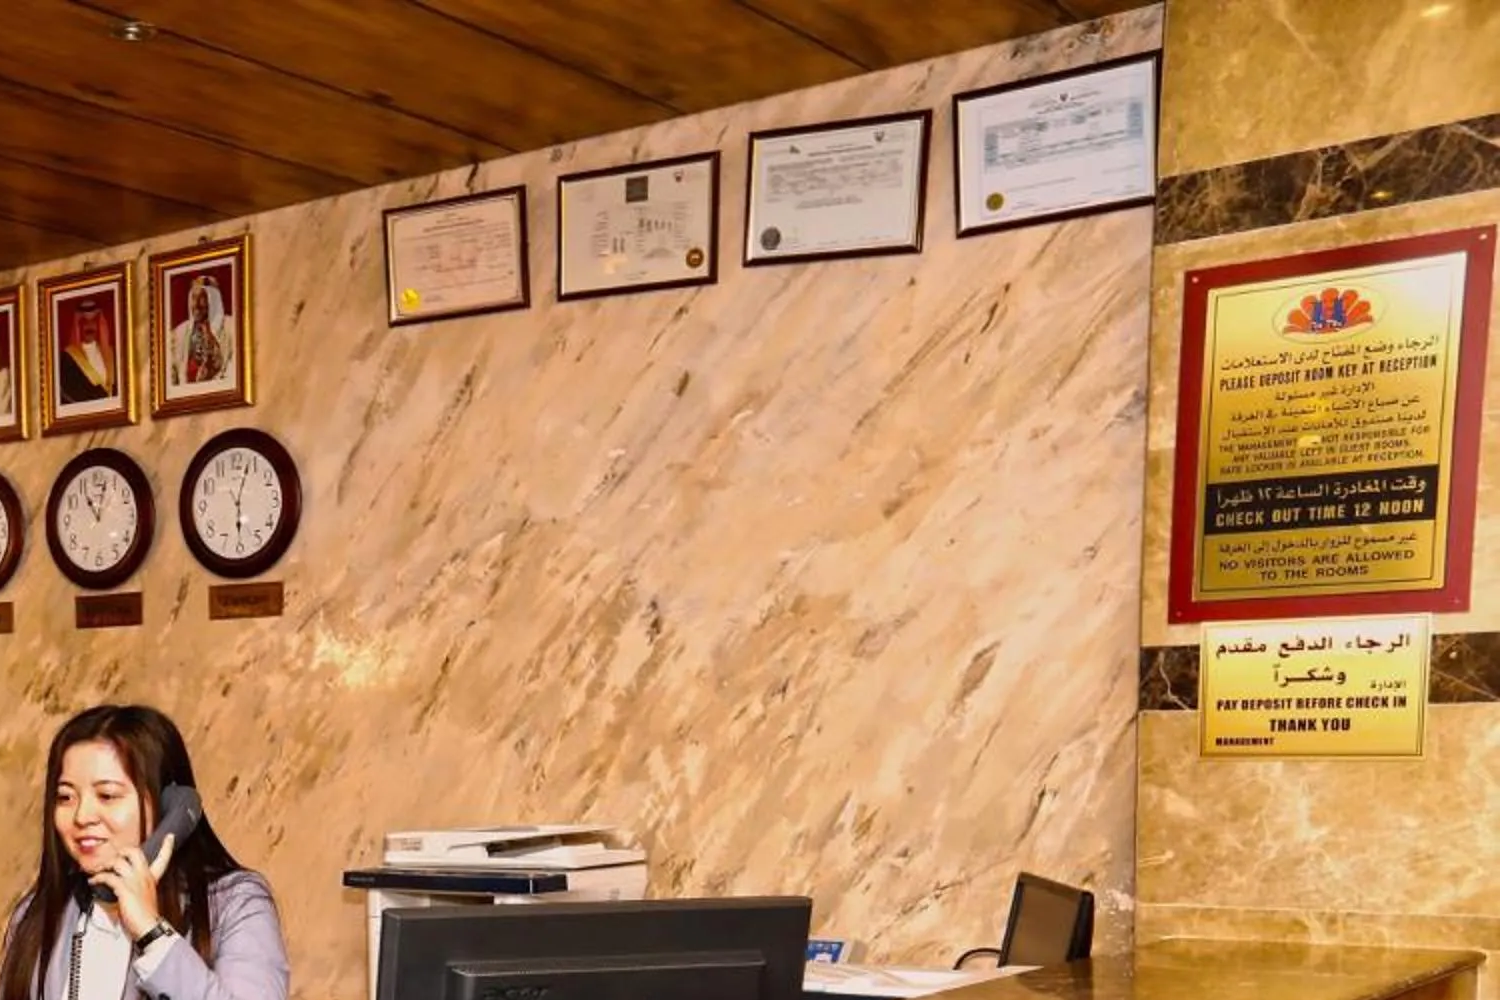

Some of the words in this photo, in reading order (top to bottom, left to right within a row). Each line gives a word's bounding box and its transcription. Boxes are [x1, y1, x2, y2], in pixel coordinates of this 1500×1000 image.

[1220, 375, 1256, 392] PLEASE
[1260, 369, 1301, 387] DEPOSIT
[1304, 366, 1334, 383] ROOM
[1338, 363, 1358, 378] KEY
[1361, 361, 1376, 375] AT
[1379, 354, 1438, 373] RECEPTION
[1219, 443, 1234, 453] THE
[1238, 438, 1298, 451] MANAGEMENT
[1321, 434, 1339, 444] NOT
[1411, 424, 1431, 435] FOR
[1300, 446, 1323, 457] LEFT
[1276, 482, 1330, 500] الساعة
[1333, 479, 1387, 500] المغادرة
[1390, 474, 1427, 494] وقت
[1215, 510, 1265, 528] CHECK
[1271, 506, 1302, 524] OUT
[1308, 503, 1347, 521] TIME
[1353, 501, 1372, 518] 12
[1379, 498, 1425, 516] NOON
[1219, 559, 1239, 572] NO
[1244, 556, 1305, 569] VISITORS
[1312, 552, 1340, 565] ARE
[1345, 548, 1416, 563] ALLOWED
[1260, 570, 1277, 581] TO
[1284, 568, 1308, 580] THE
[1315, 564, 1370, 578] ROOMS
[1216, 637, 1268, 661] مقدم
[1278, 634, 1334, 659] الدفع
[1345, 632, 1411, 655] الرجاء
[1216, 699, 1238, 712] PAY
[1241, 698, 1293, 711] DEPOSIT
[1296, 697, 1343, 710] BEFORE
[1345, 695, 1390, 709] CHECK
[1393, 695, 1408, 709] IN
[1268, 718, 1318, 733] THANK
[1321, 717, 1352, 732] YOU
